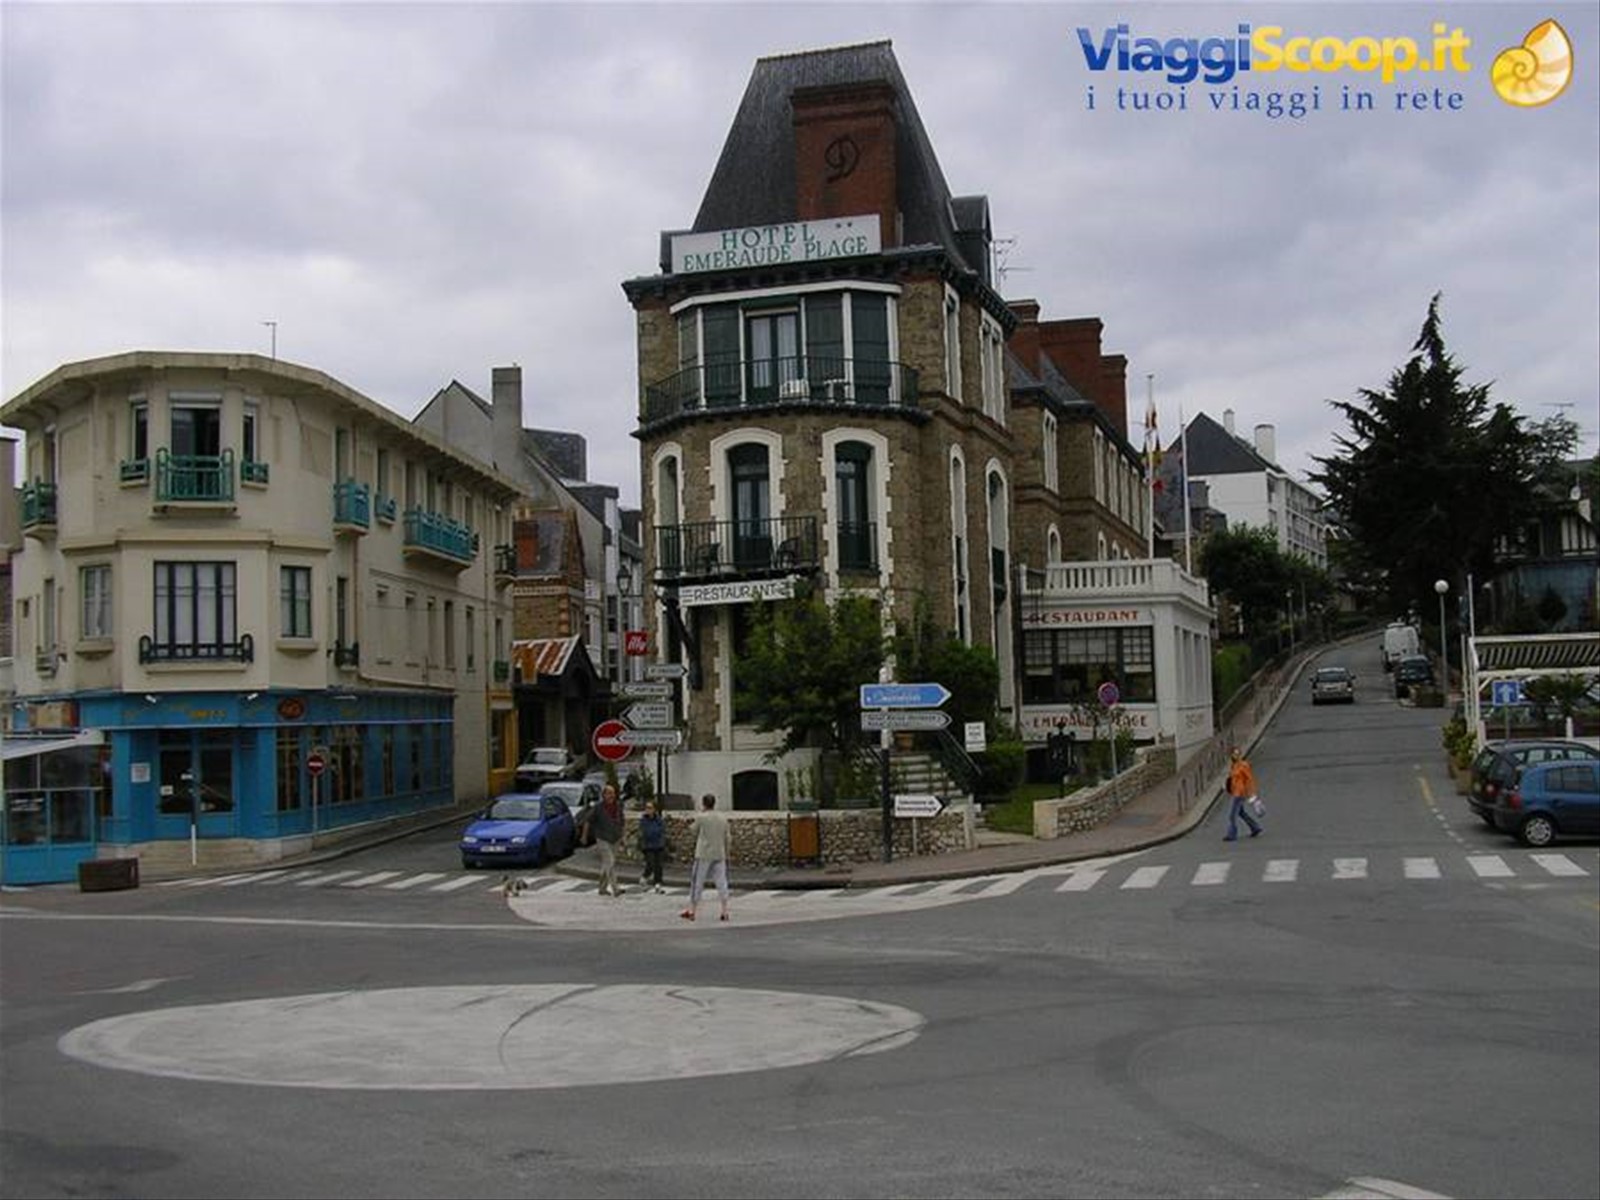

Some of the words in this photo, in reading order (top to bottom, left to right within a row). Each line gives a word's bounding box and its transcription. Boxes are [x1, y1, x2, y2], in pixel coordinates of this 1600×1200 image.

[721, 224, 816, 251] HOTEL
[683, 244, 792, 272] EMERAUDE
[804, 235, 869, 260] PLAGE
[693, 585, 776, 602] RESTAURANT
[1029, 610, 1138, 624] RESTAURANT
